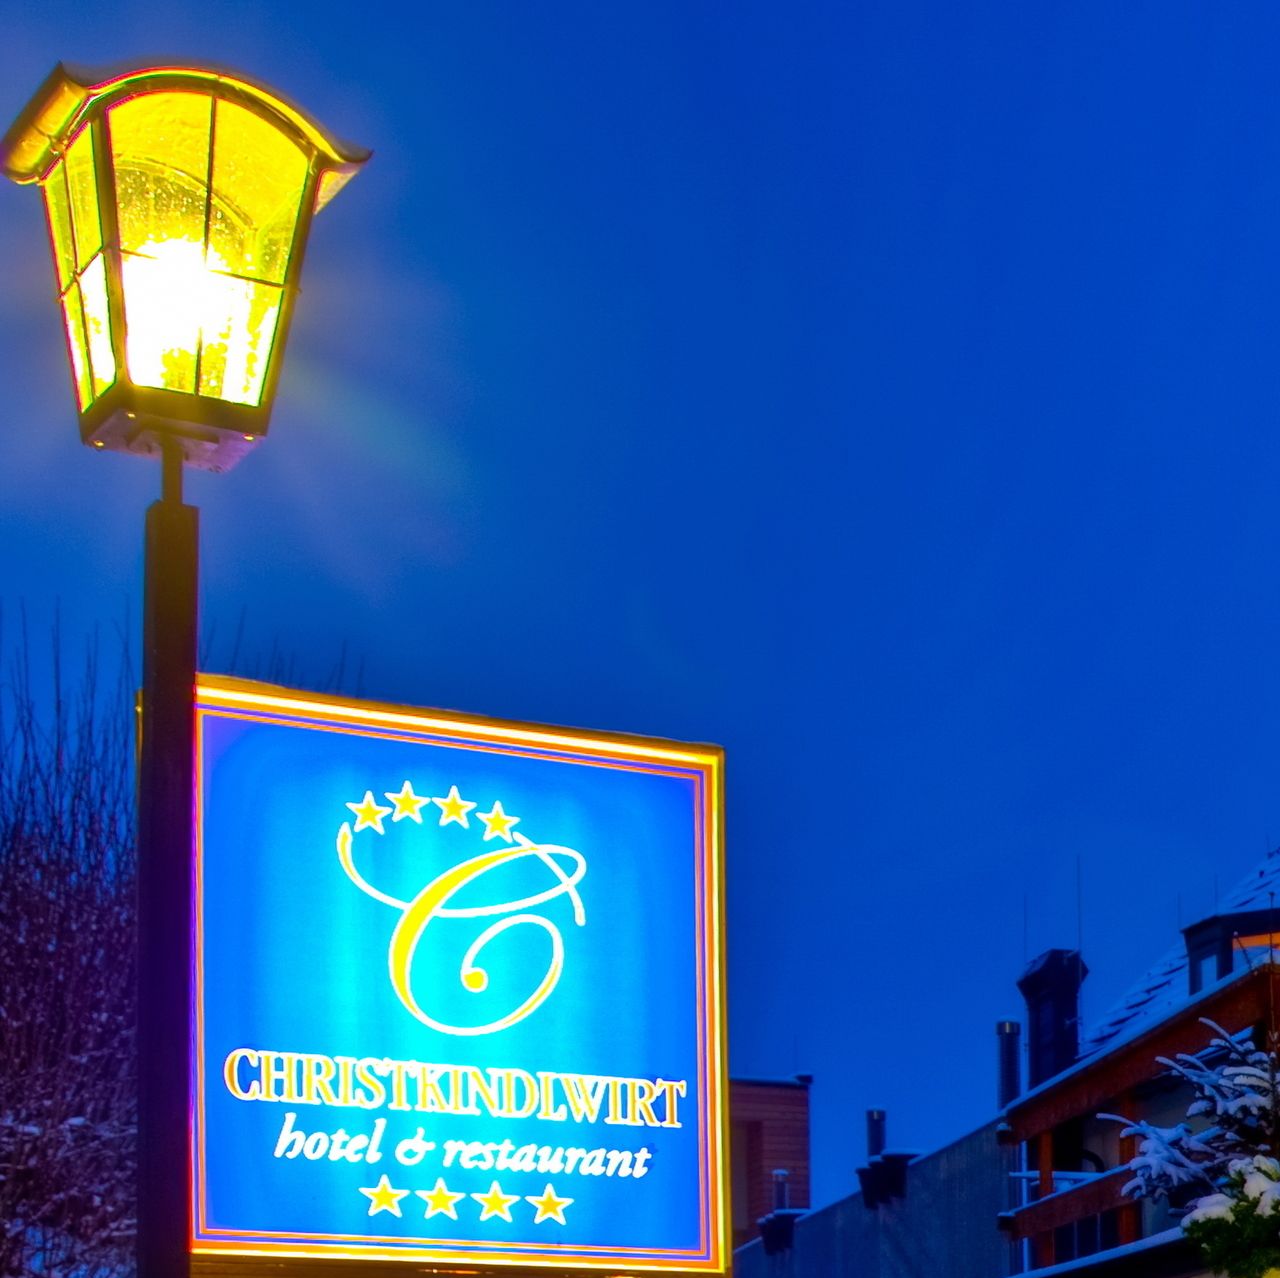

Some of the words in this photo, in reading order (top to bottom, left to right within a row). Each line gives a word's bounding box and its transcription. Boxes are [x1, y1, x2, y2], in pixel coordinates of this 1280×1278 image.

[223, 1047, 688, 1129] CHRISTKINDLWIRT
[274, 1113, 387, 1164] hotel
[394, 1128, 436, 1167] &
[442, 1139, 653, 1179] restaurant
